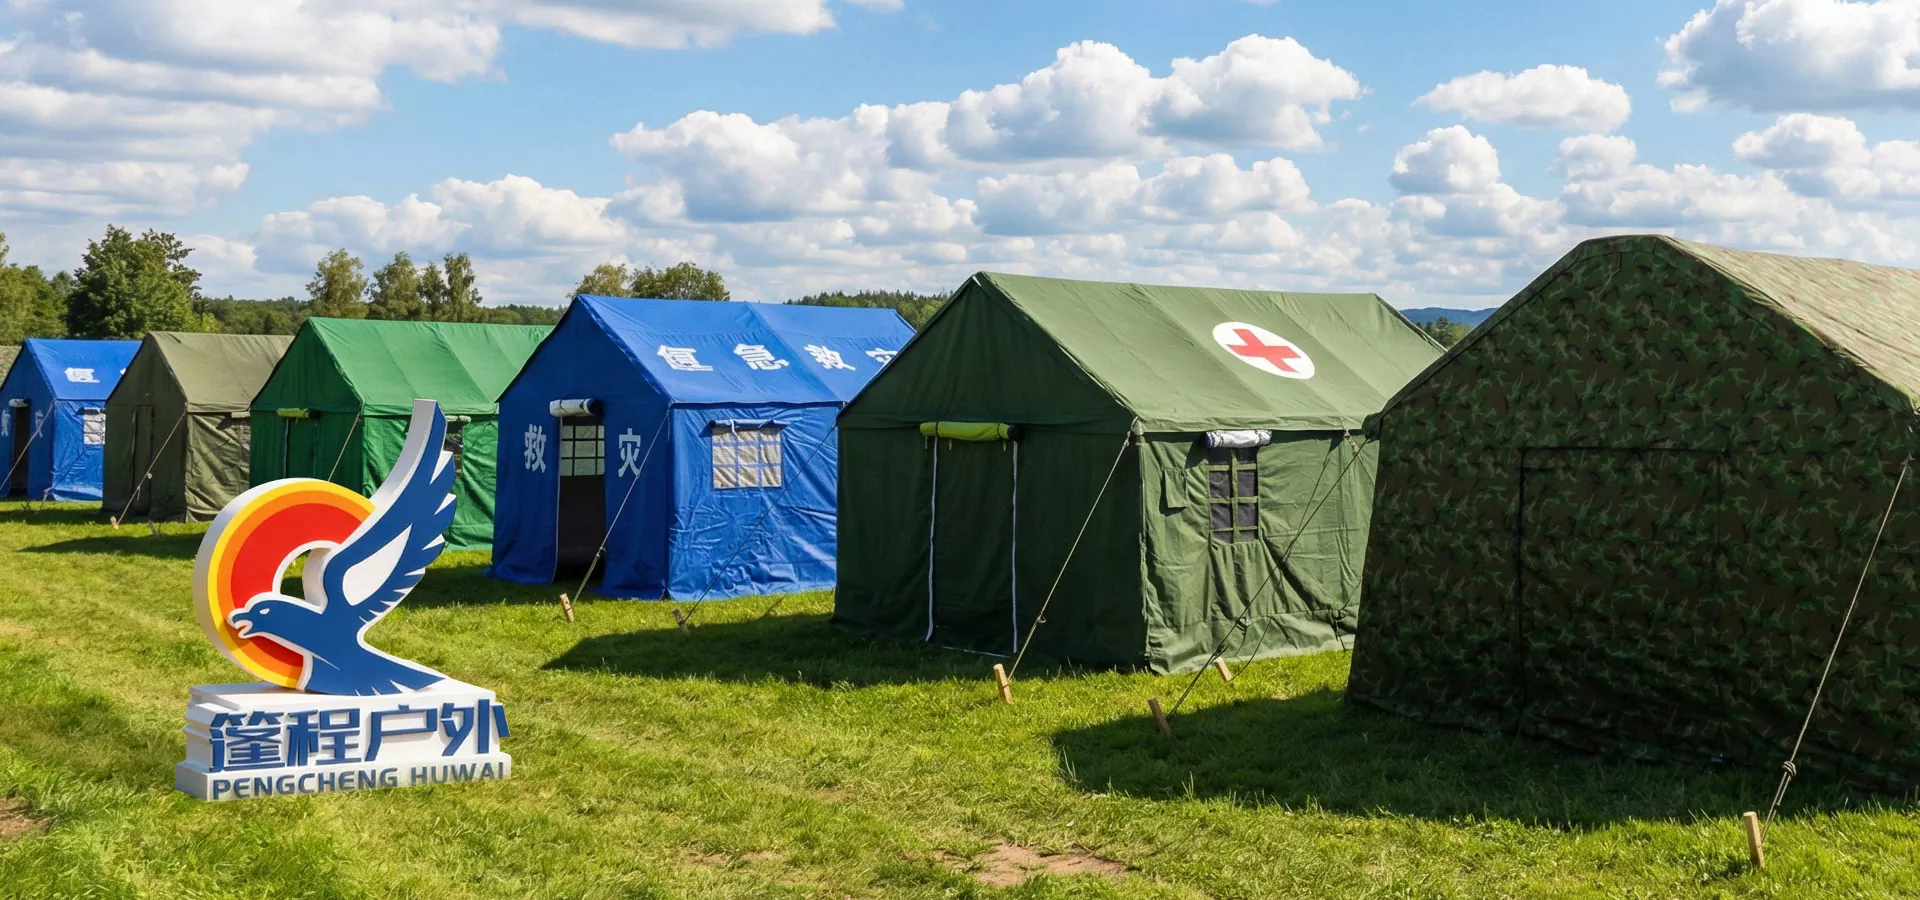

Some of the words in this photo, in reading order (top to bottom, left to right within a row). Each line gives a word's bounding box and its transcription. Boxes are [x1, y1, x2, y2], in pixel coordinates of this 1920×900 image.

[209, 699, 510, 773] 篷程户外
[213, 768, 398, 800] PENGCHENG
[411, 762, 504, 785] HUWAI
